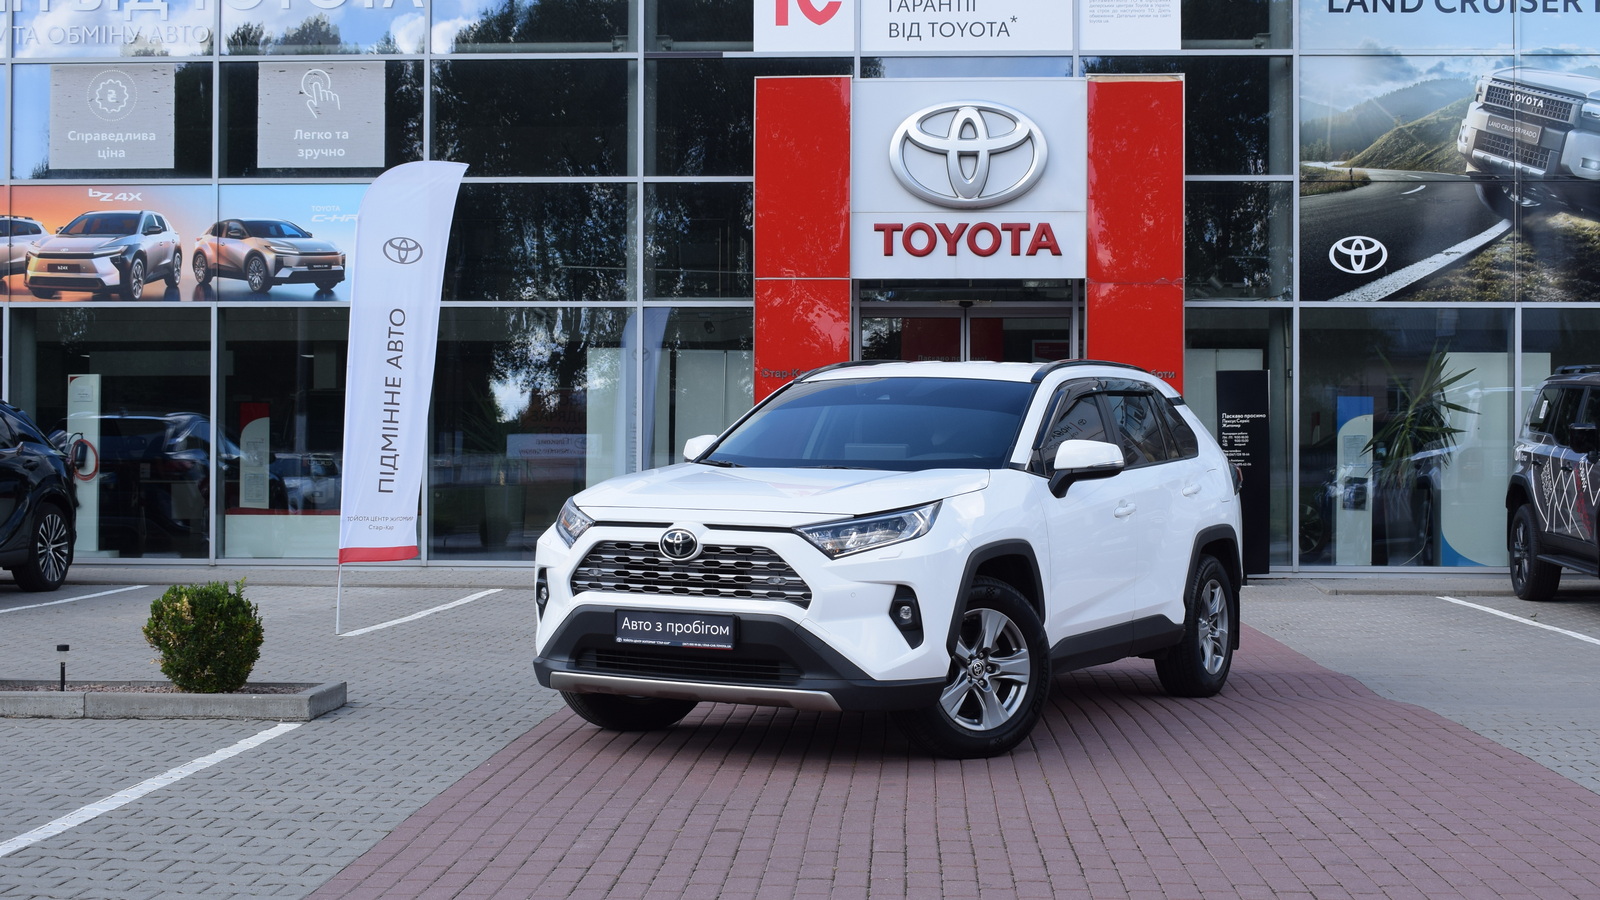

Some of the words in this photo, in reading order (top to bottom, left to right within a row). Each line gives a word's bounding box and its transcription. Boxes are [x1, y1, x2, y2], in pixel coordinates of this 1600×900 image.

[12, 25, 40, 44] ТА
[48, 25, 142, 44] ОБМІНУ
[150, 25, 211, 44] АВТО
[888, 22, 922, 41] ВІД
[1509, 93, 1543, 108] TOYOTA
[67, 129, 156, 144] Справедлива
[293, 129, 331, 141] Легко
[335, 131, 349, 140] та
[1488, 120, 1501, 129] LAND
[1520, 128, 1537, 138] PRADO
[97, 147, 126, 160] ціна
[297, 147, 346, 159] зручно
[88, 188, 142, 202] bZ4X
[873, 222, 1062, 257] TOYOTA
[386, 308, 407, 370] АВТО
[760, 367, 805, 380] Стар-К
[378, 376, 402, 494] ПІДМІННЕ
[347, 514, 370, 522] ТОЙОТА
[621, 616, 652, 631] Авто
[655, 621, 663, 632] з
[666, 620, 730, 636] пробігом
